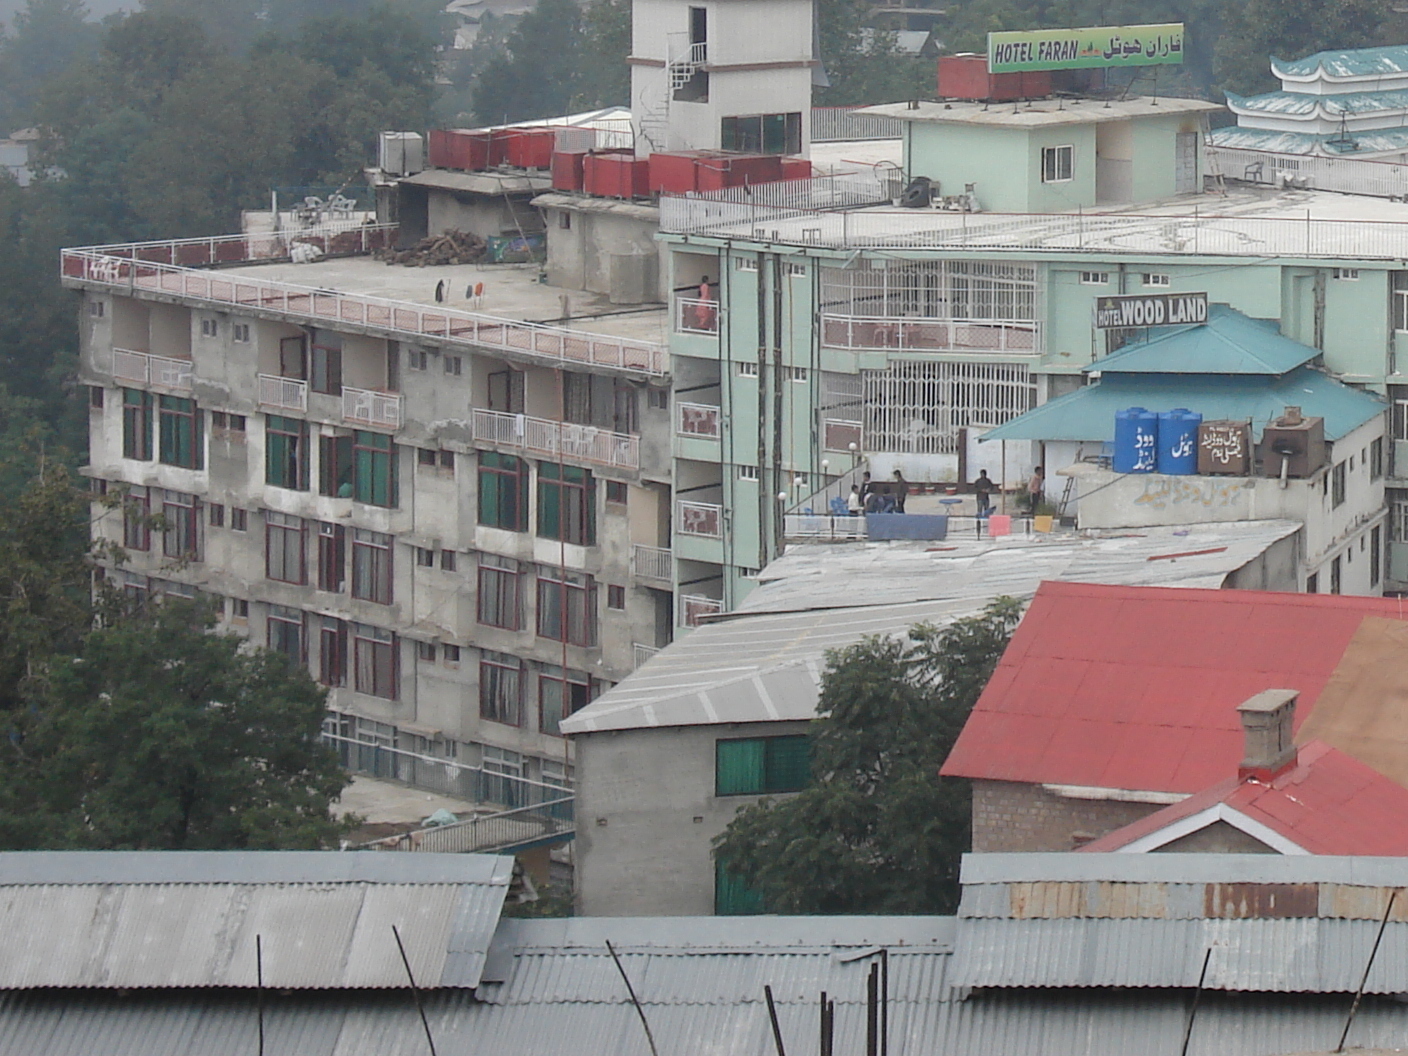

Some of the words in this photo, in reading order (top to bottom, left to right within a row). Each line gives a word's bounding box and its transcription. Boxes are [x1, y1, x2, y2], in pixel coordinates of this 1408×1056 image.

[995, 42, 1033, 64] HOTEL
[1038, 40, 1079, 62] FARAN
[1098, 309, 1122, 326] HOTEL
[1121, 299, 1164, 325] WOOD
[1168, 297, 1206, 323] LAND
